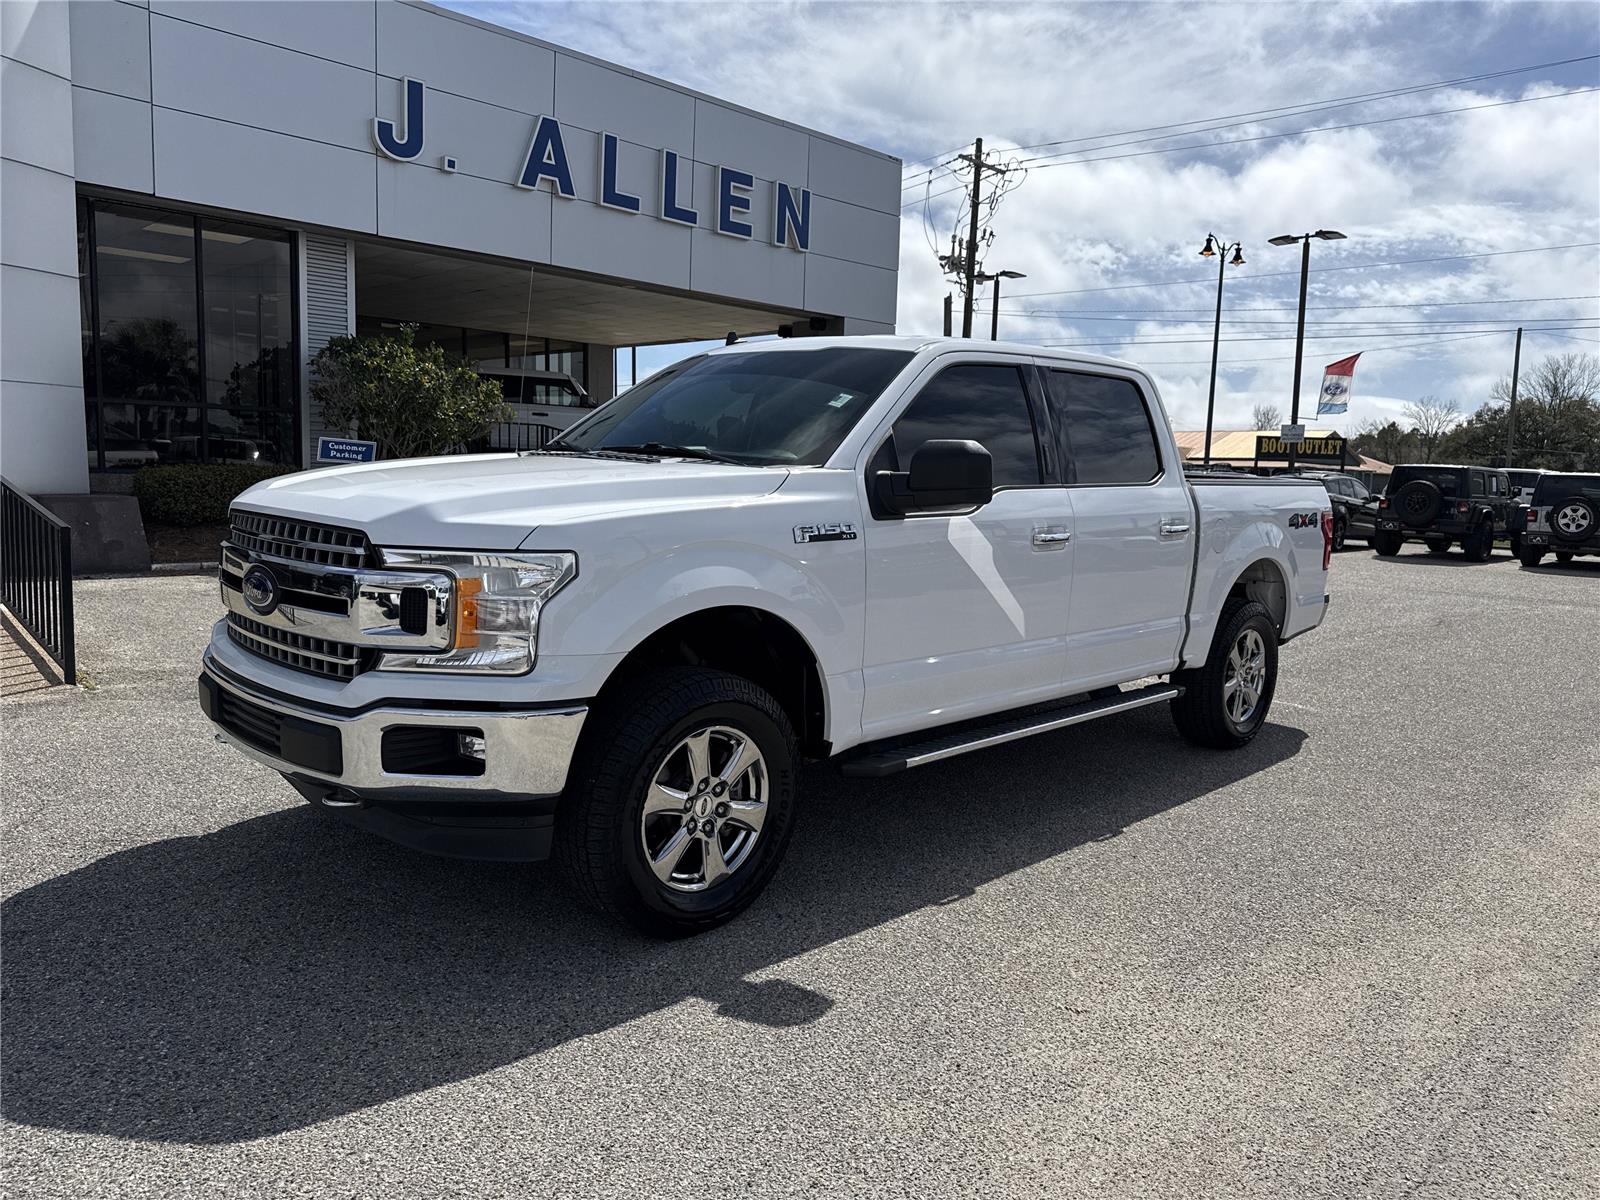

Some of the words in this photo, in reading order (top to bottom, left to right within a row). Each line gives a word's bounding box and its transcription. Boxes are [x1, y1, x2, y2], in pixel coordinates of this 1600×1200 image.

[371, 76, 458, 172] J.
[515, 114, 812, 252] ALLEN
[328, 442, 366, 452] Customer
[1297, 439, 1342, 455] OUTLET
[330, 450, 362, 460] Parking
